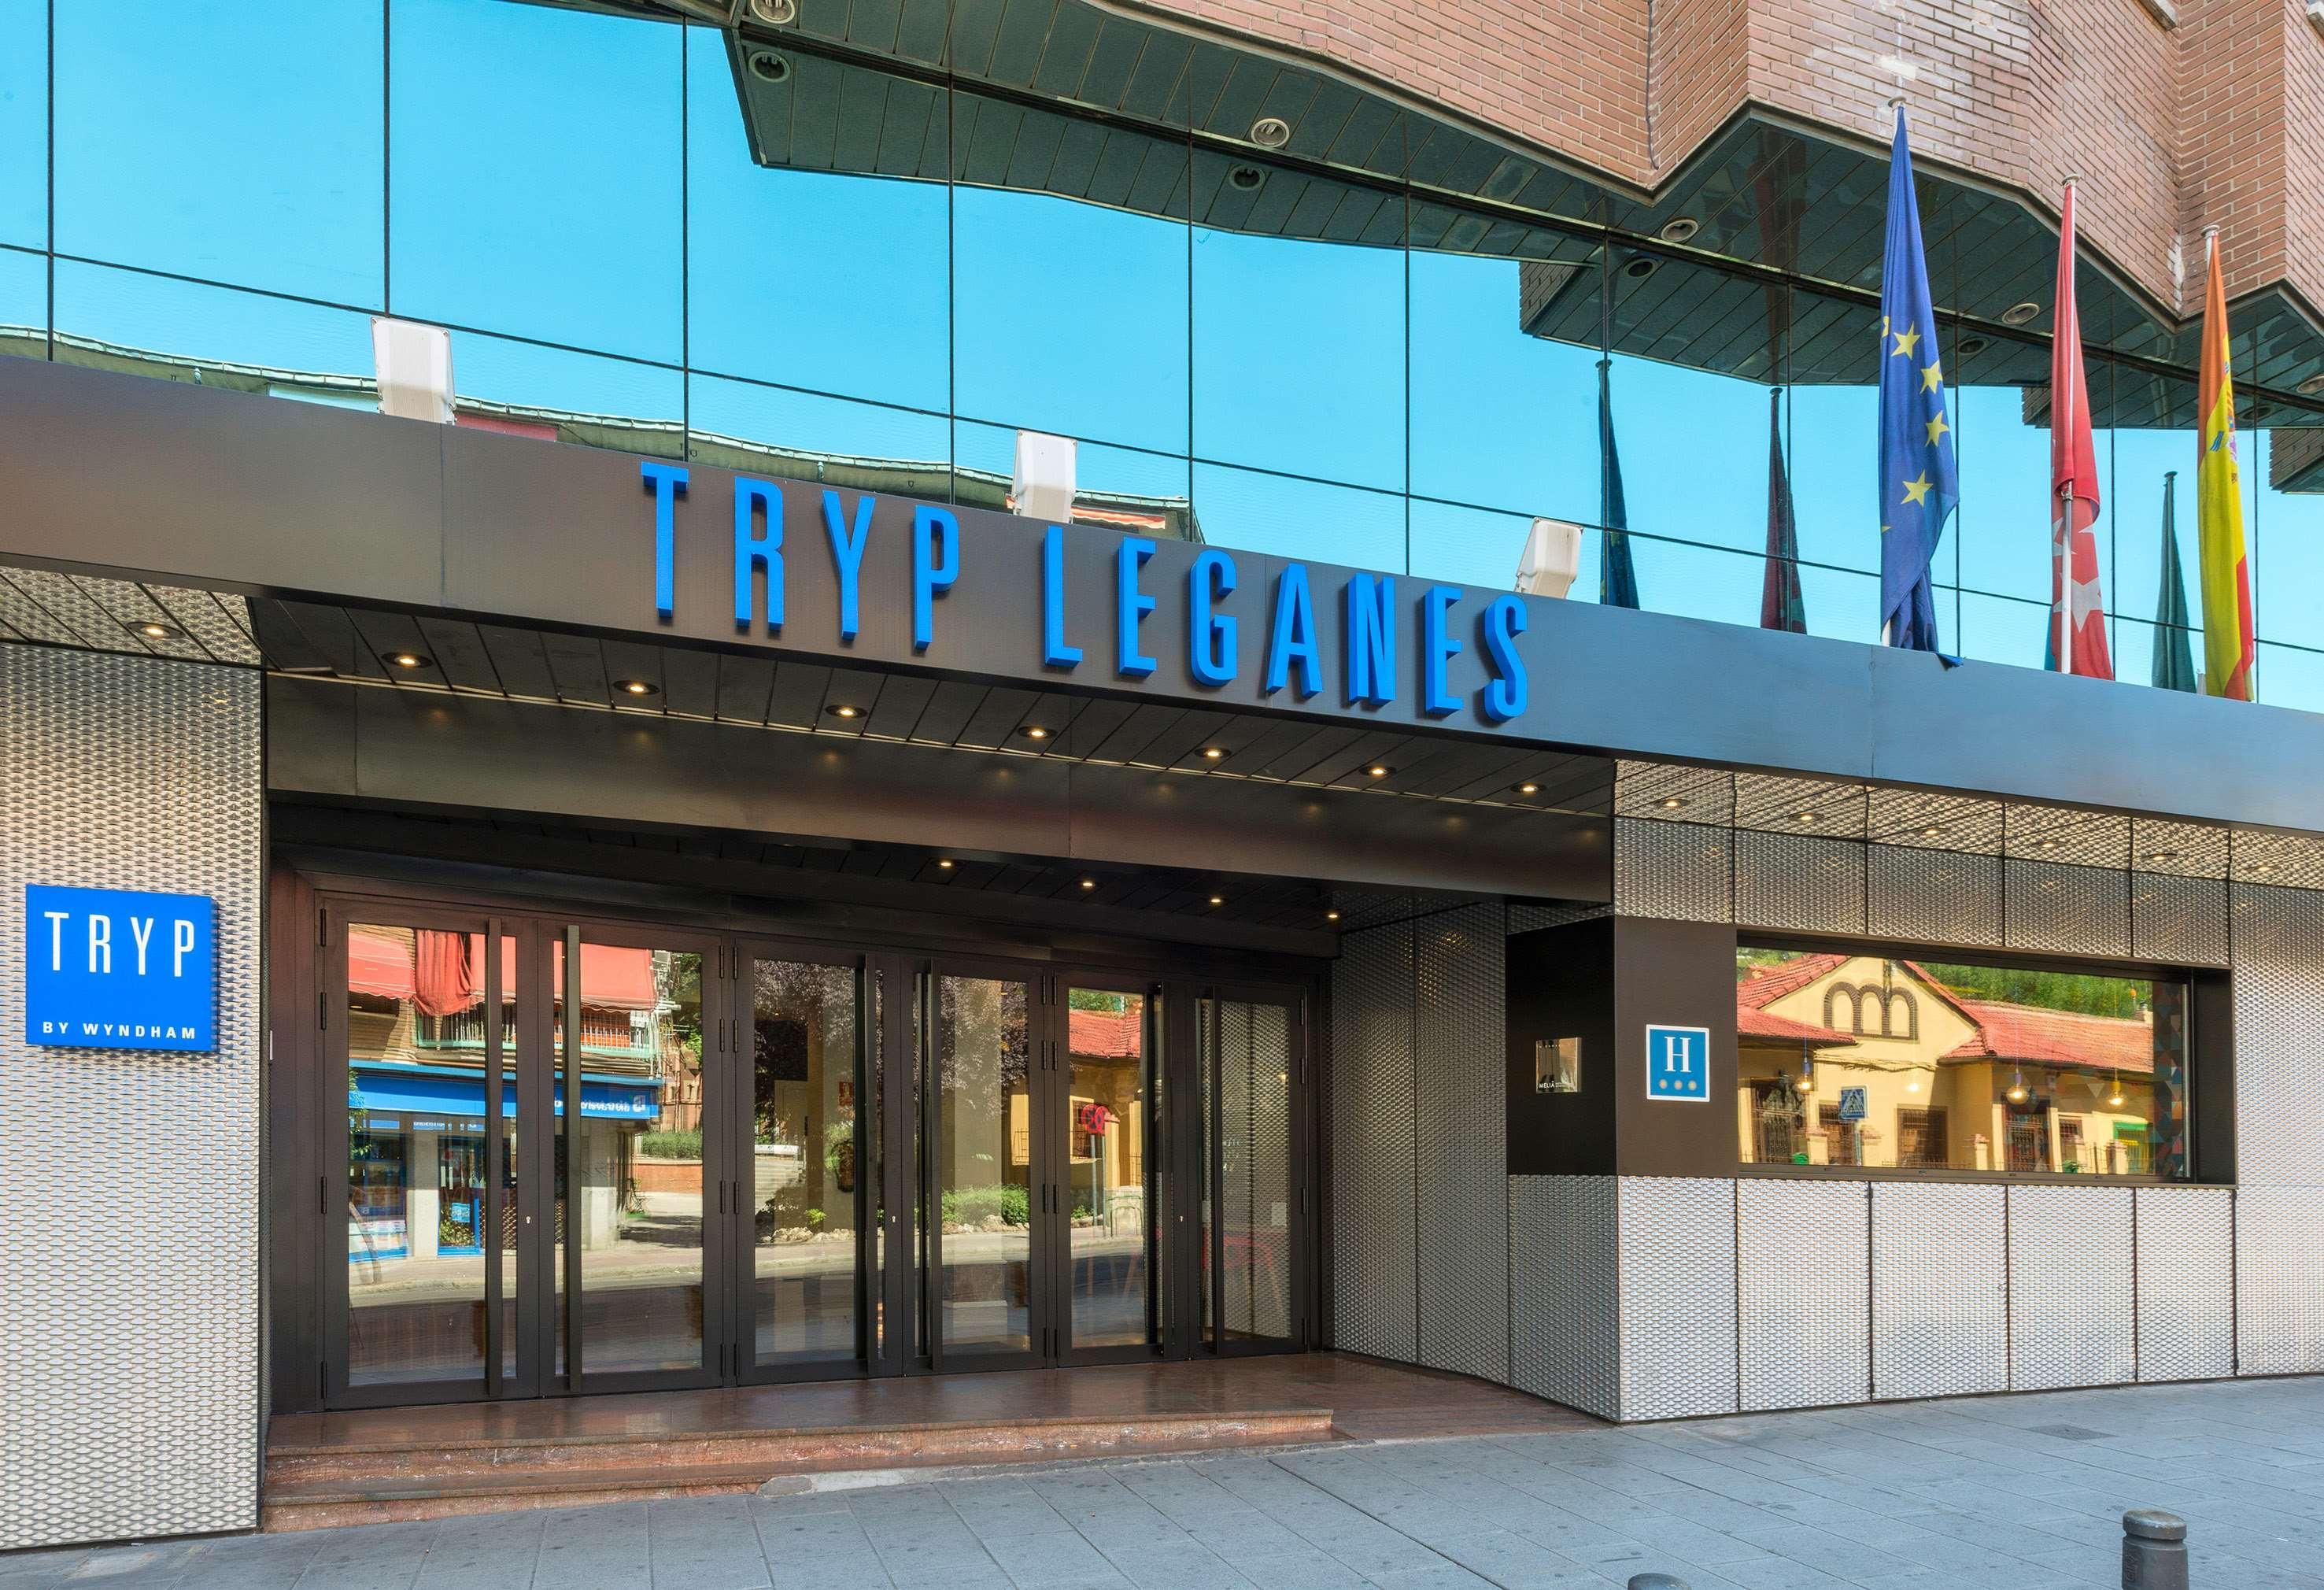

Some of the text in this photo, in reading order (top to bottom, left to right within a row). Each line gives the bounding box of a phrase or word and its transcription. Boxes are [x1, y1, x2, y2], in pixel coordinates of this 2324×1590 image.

[641, 462, 1528, 722] TRYP LEGANES
[44, 911, 194, 977] TRYP
[42, 1022, 195, 1039] BY WYNDHAM
[1664, 1036, 1691, 1072] H
